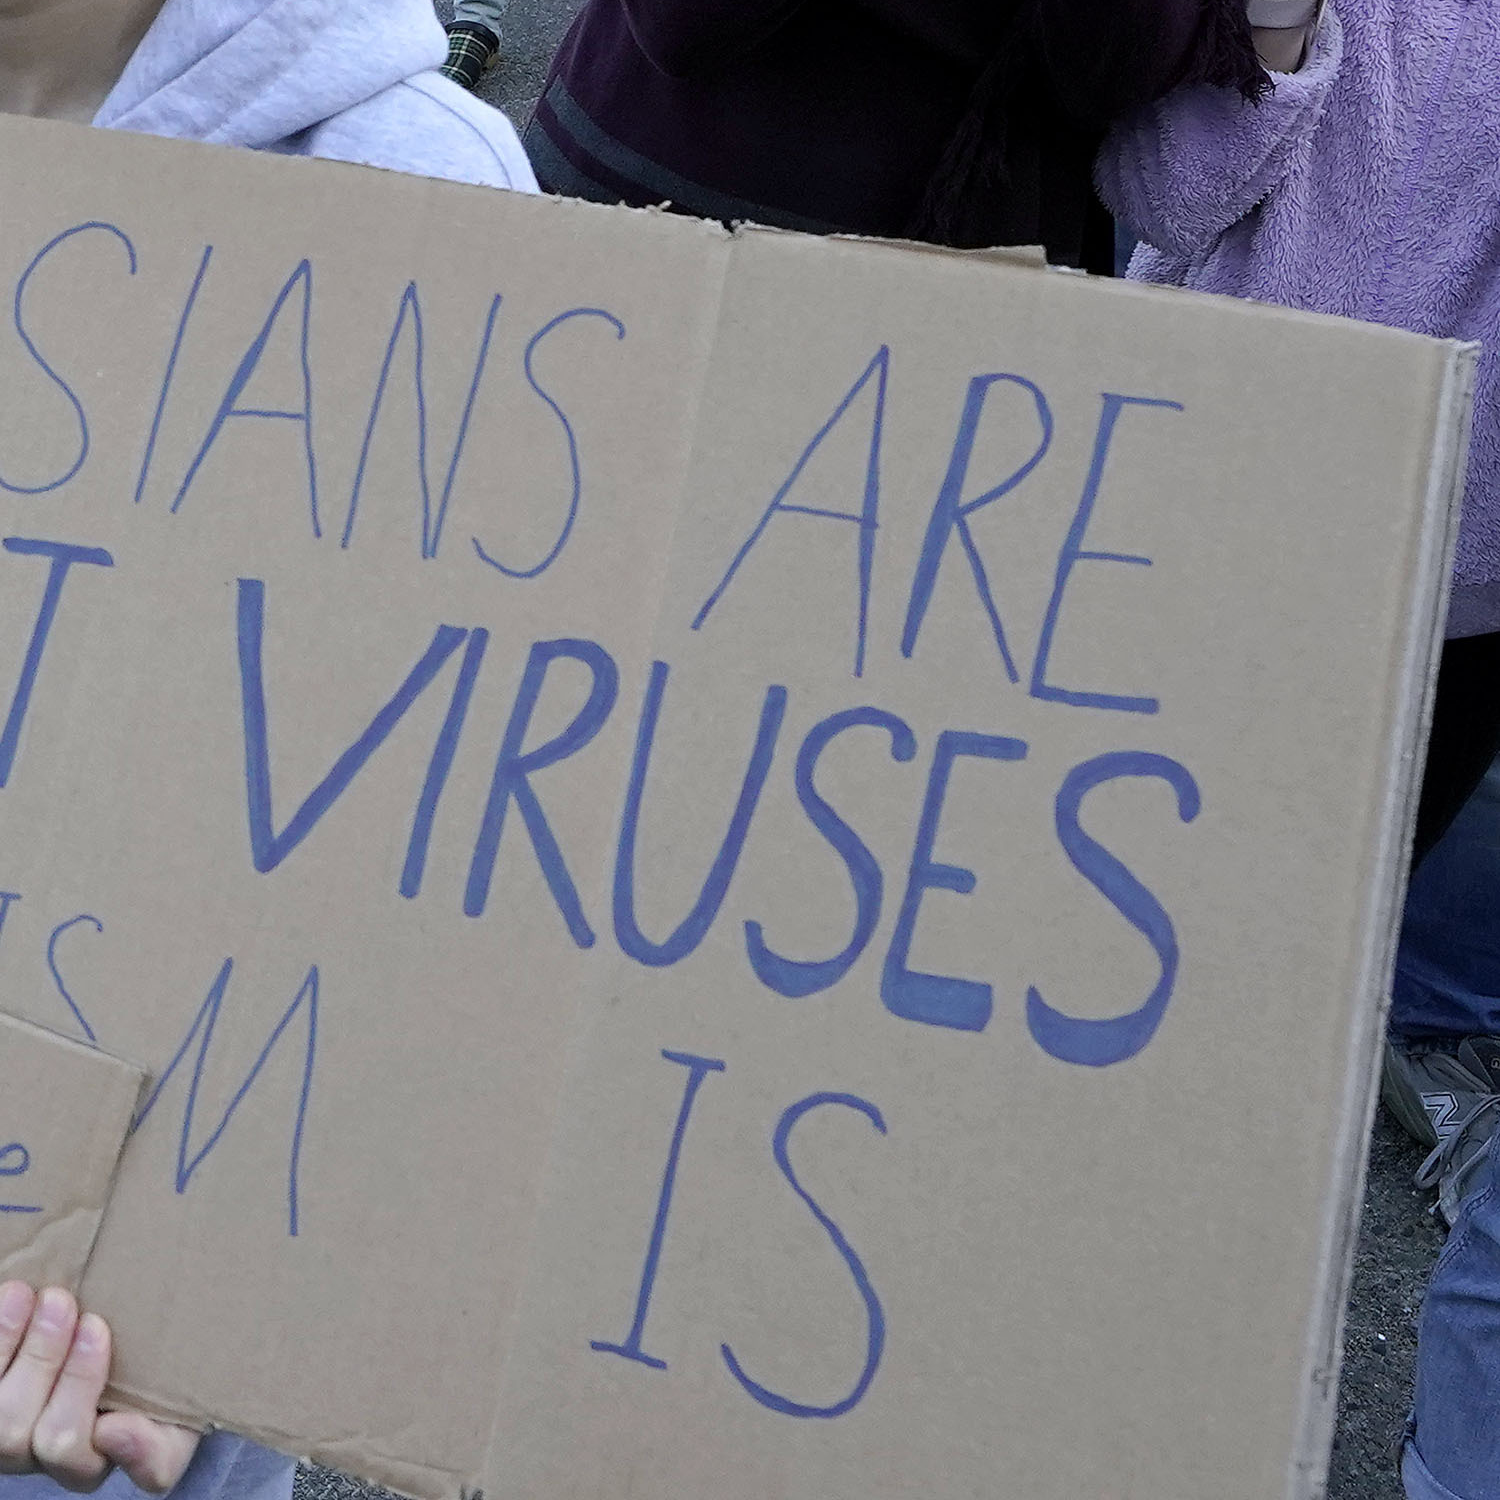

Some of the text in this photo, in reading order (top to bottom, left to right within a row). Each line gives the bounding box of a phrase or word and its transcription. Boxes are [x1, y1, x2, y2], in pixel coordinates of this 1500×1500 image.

[691, 345, 1185, 713] ARE
[235, 578, 1200, 1068] VIRUSES
[590, 1050, 888, 1418] IS
